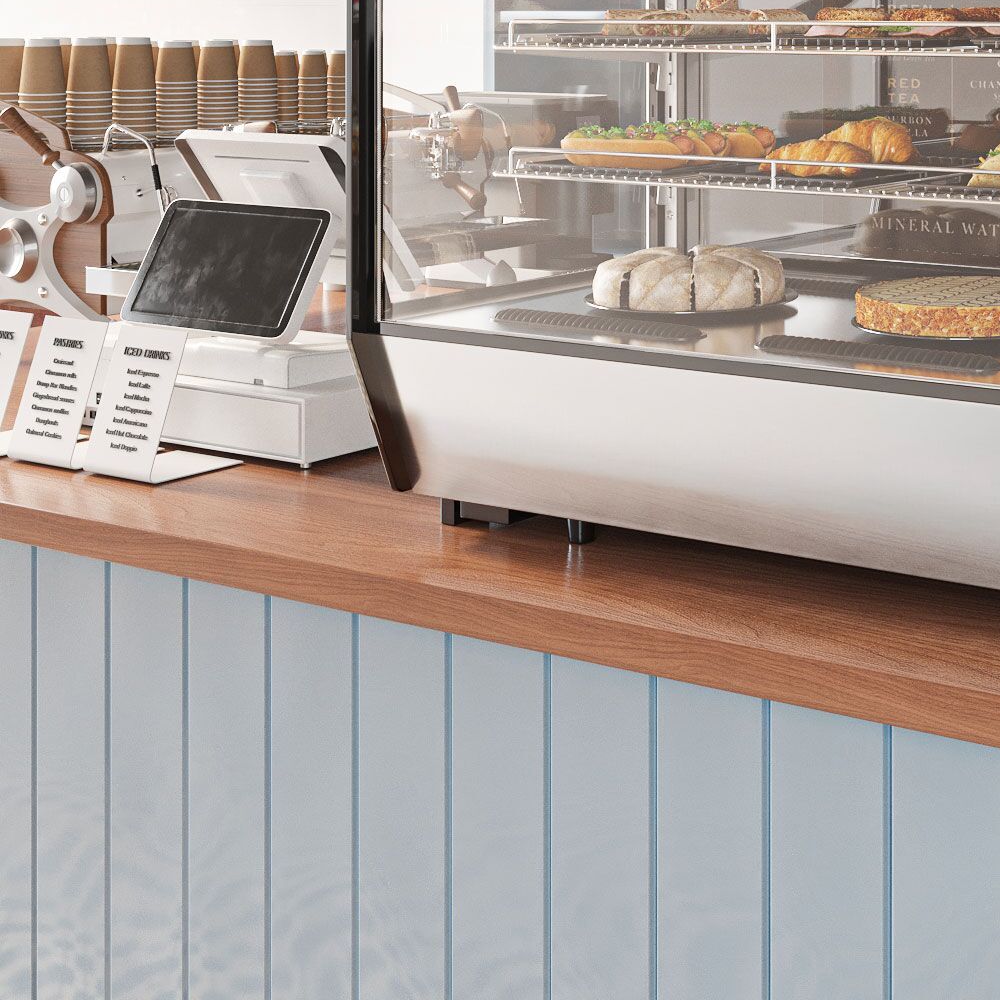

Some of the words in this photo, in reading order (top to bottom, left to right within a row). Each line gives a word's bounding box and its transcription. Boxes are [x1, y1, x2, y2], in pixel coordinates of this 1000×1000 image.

[888, 78, 921, 88] RED
[888, 92, 921, 104] TEA
[871, 215, 955, 234] MINERAL
[53, 337, 84, 349] PASTRIES
[123, 346, 143, 357] ICED
[144, 349, 171, 360] DRINKS
